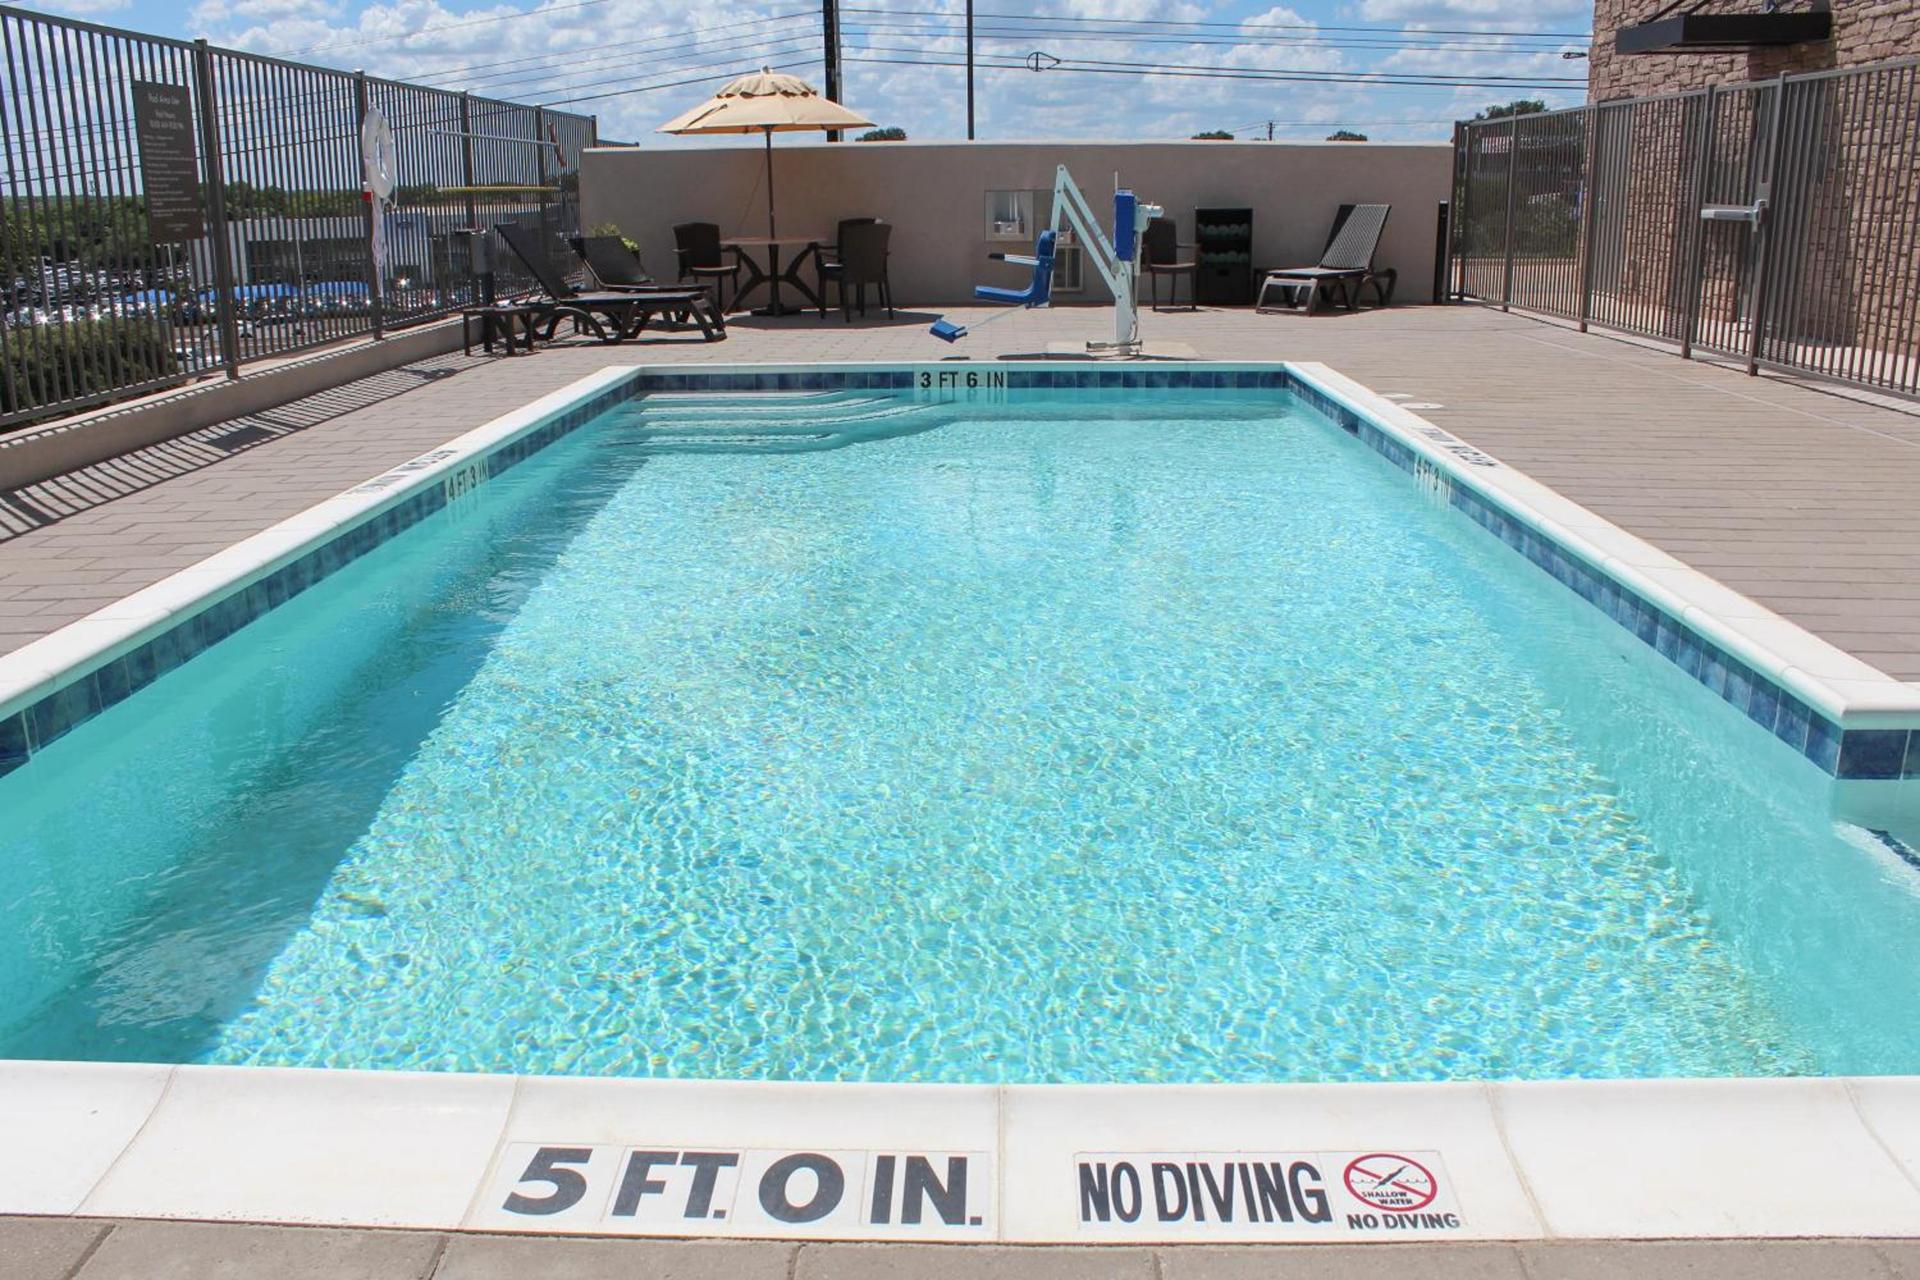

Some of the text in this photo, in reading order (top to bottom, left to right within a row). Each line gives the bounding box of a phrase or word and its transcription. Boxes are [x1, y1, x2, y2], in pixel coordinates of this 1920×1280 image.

[920, 371, 1004, 388] 3 FT 6 IN
[448, 477, 455, 501] 4
[456, 468, 467, 496] FT
[470, 465, 477, 488] 3
[478, 459, 487, 483] IN
[502, 1146, 594, 1216] 5
[611, 1150, 740, 1219] FT.
[869, 1155, 983, 1226] IN.
[1078, 1161, 1333, 1224] NO DIVING
[1362, 1190, 1408, 1198] SHALLOW
[1347, 1213, 1461, 1229] NO DIVING
